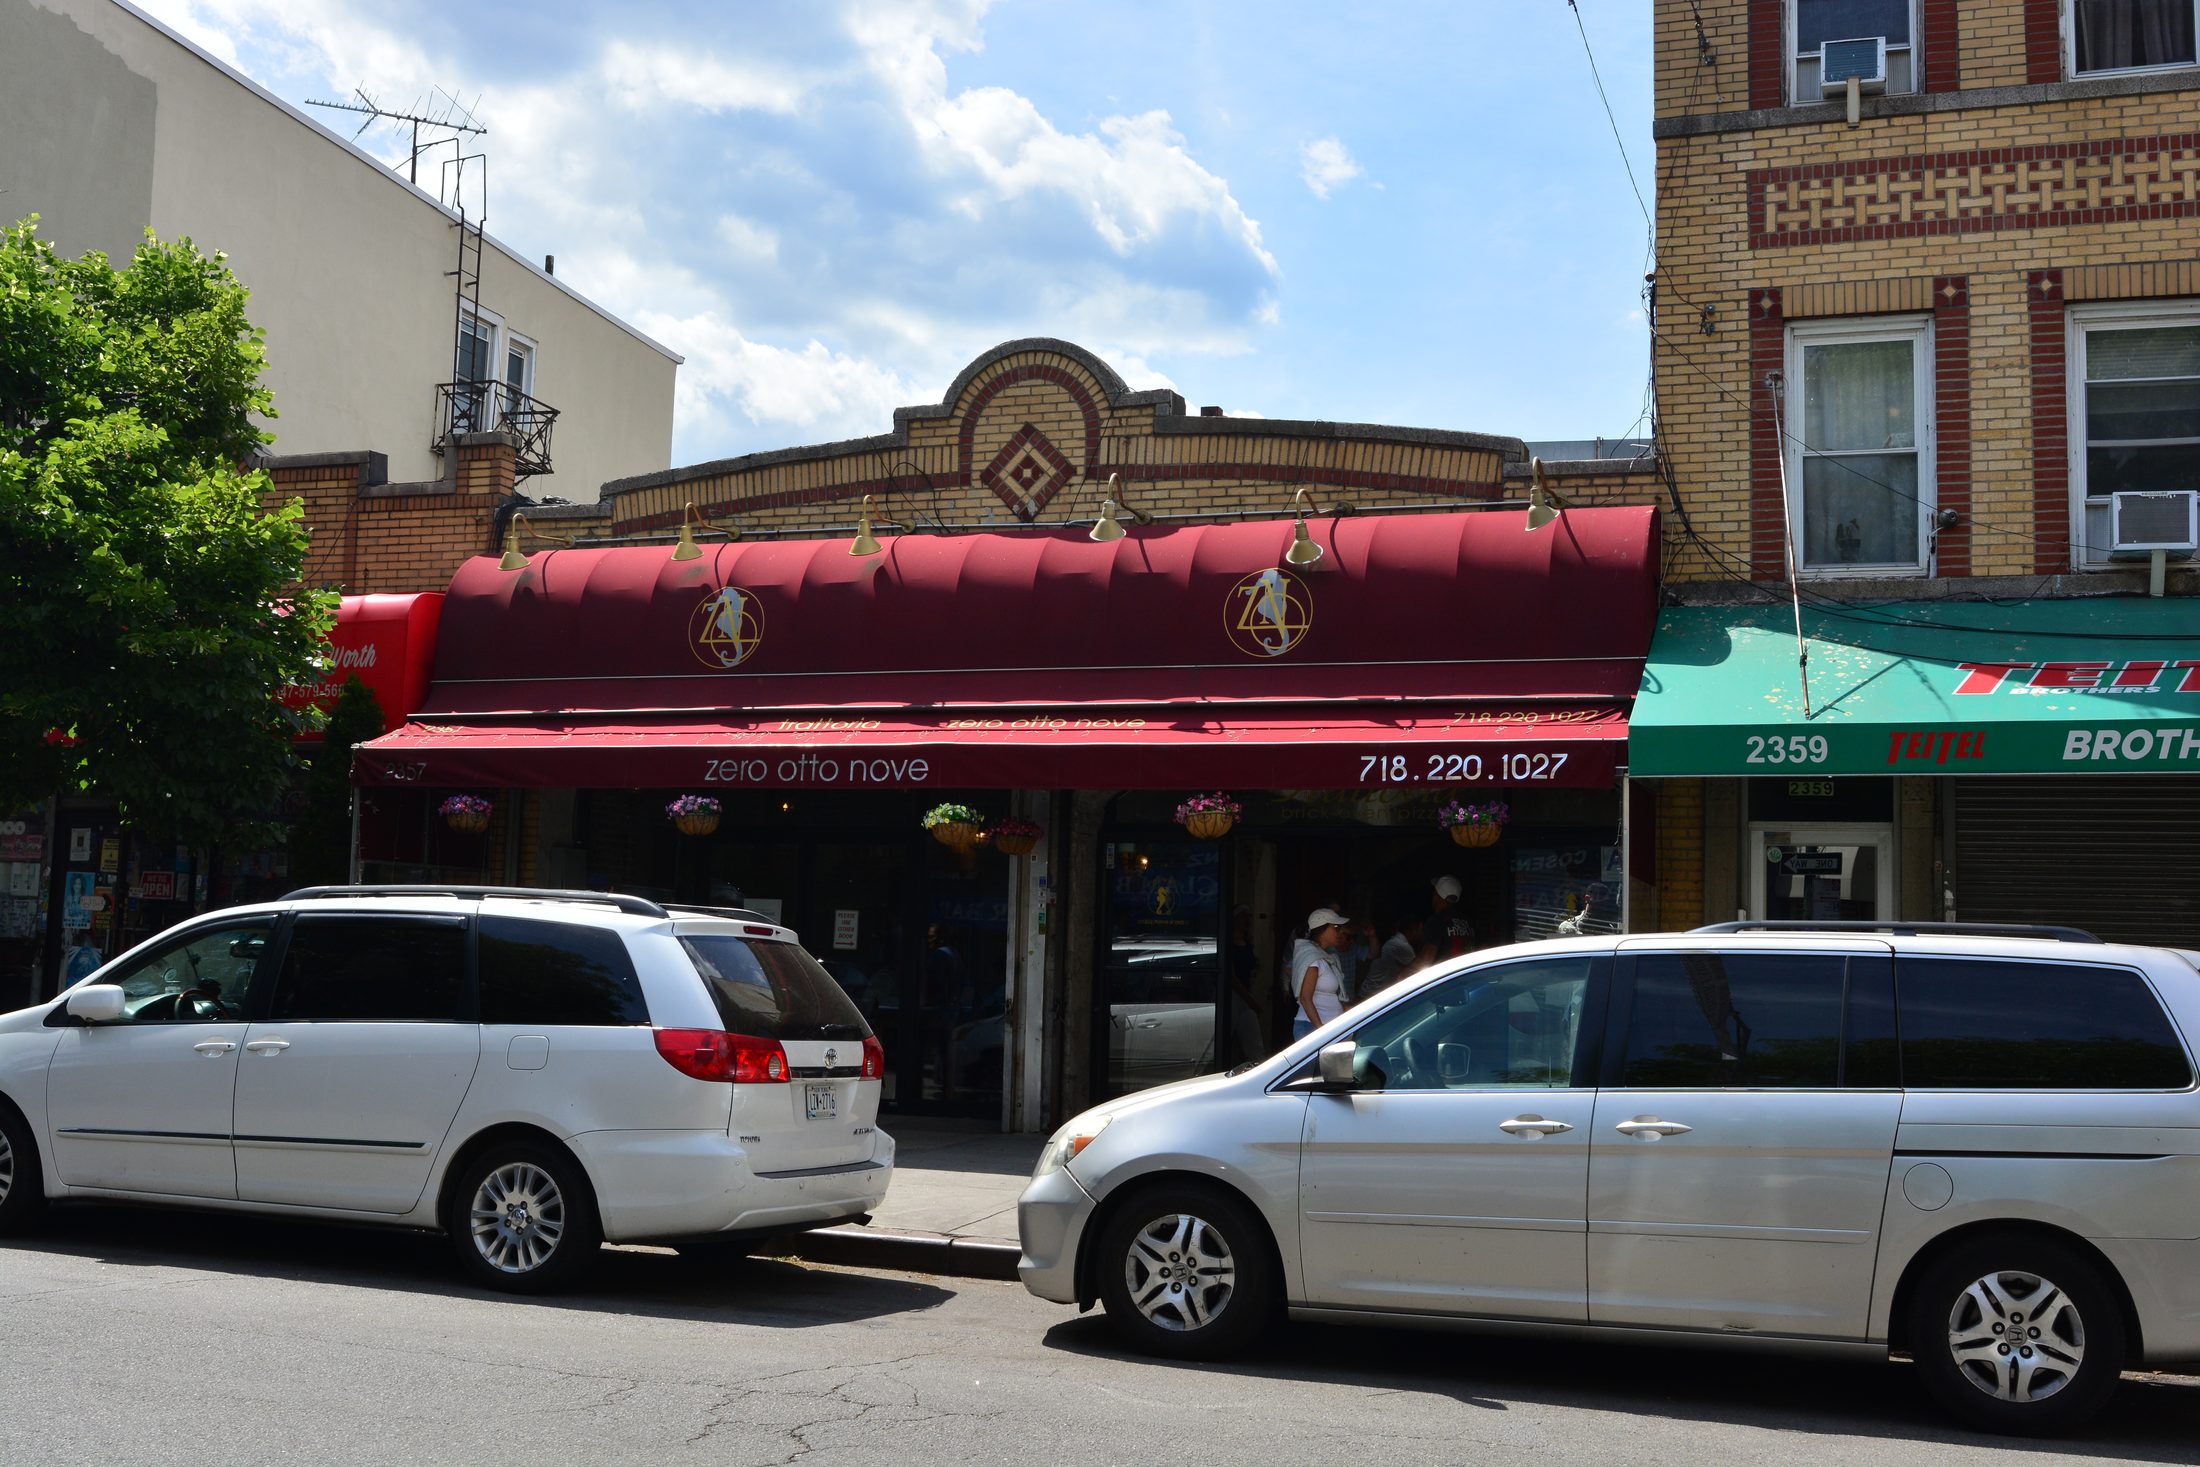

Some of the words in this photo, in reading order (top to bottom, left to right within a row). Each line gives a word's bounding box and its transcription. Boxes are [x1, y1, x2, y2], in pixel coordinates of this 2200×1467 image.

[2009, 686, 2161, 696] BROTHERS
[777, 717, 881, 731] trattoria
[946, 718, 1004, 729] zero
[1011, 714, 1067, 728] otto
[1073, 717, 1146, 728] nove
[1746, 735, 1829, 764] 2359
[1887, 731, 1986, 765] TEITEL
[704, 758, 768, 782] zero
[777, 753, 839, 782] otto
[849, 758, 929, 782] nove
[1359, 752, 1569, 782] 718.220.1027
[1790, 782, 1833, 795] 2359
